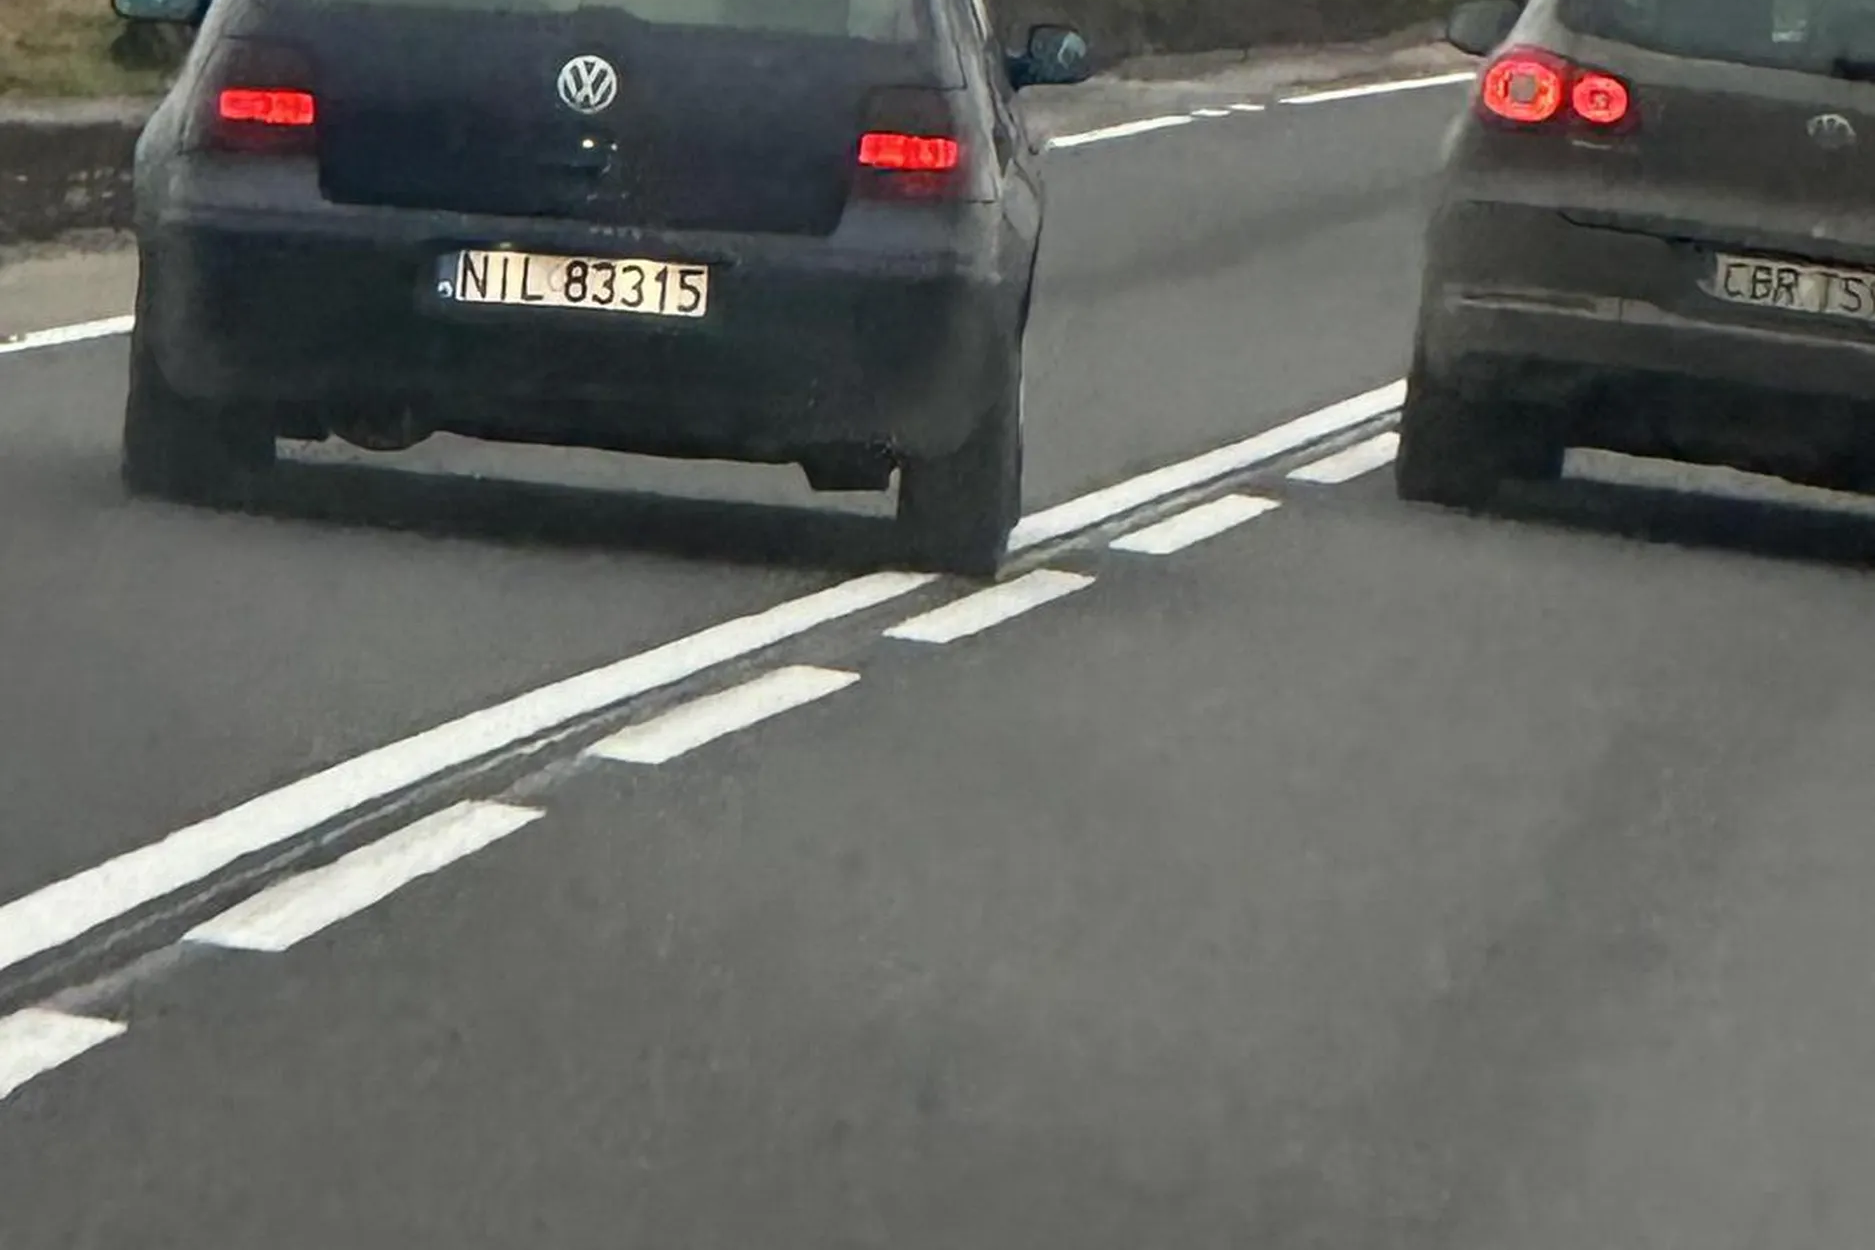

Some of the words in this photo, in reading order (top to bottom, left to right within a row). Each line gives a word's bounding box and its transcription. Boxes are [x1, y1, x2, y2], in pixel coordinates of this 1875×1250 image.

[557, 55, 617, 113] VW
[460, 253, 544, 301] NIL
[564, 260, 706, 313] 83315
[1724, 262, 1798, 306] CBR
